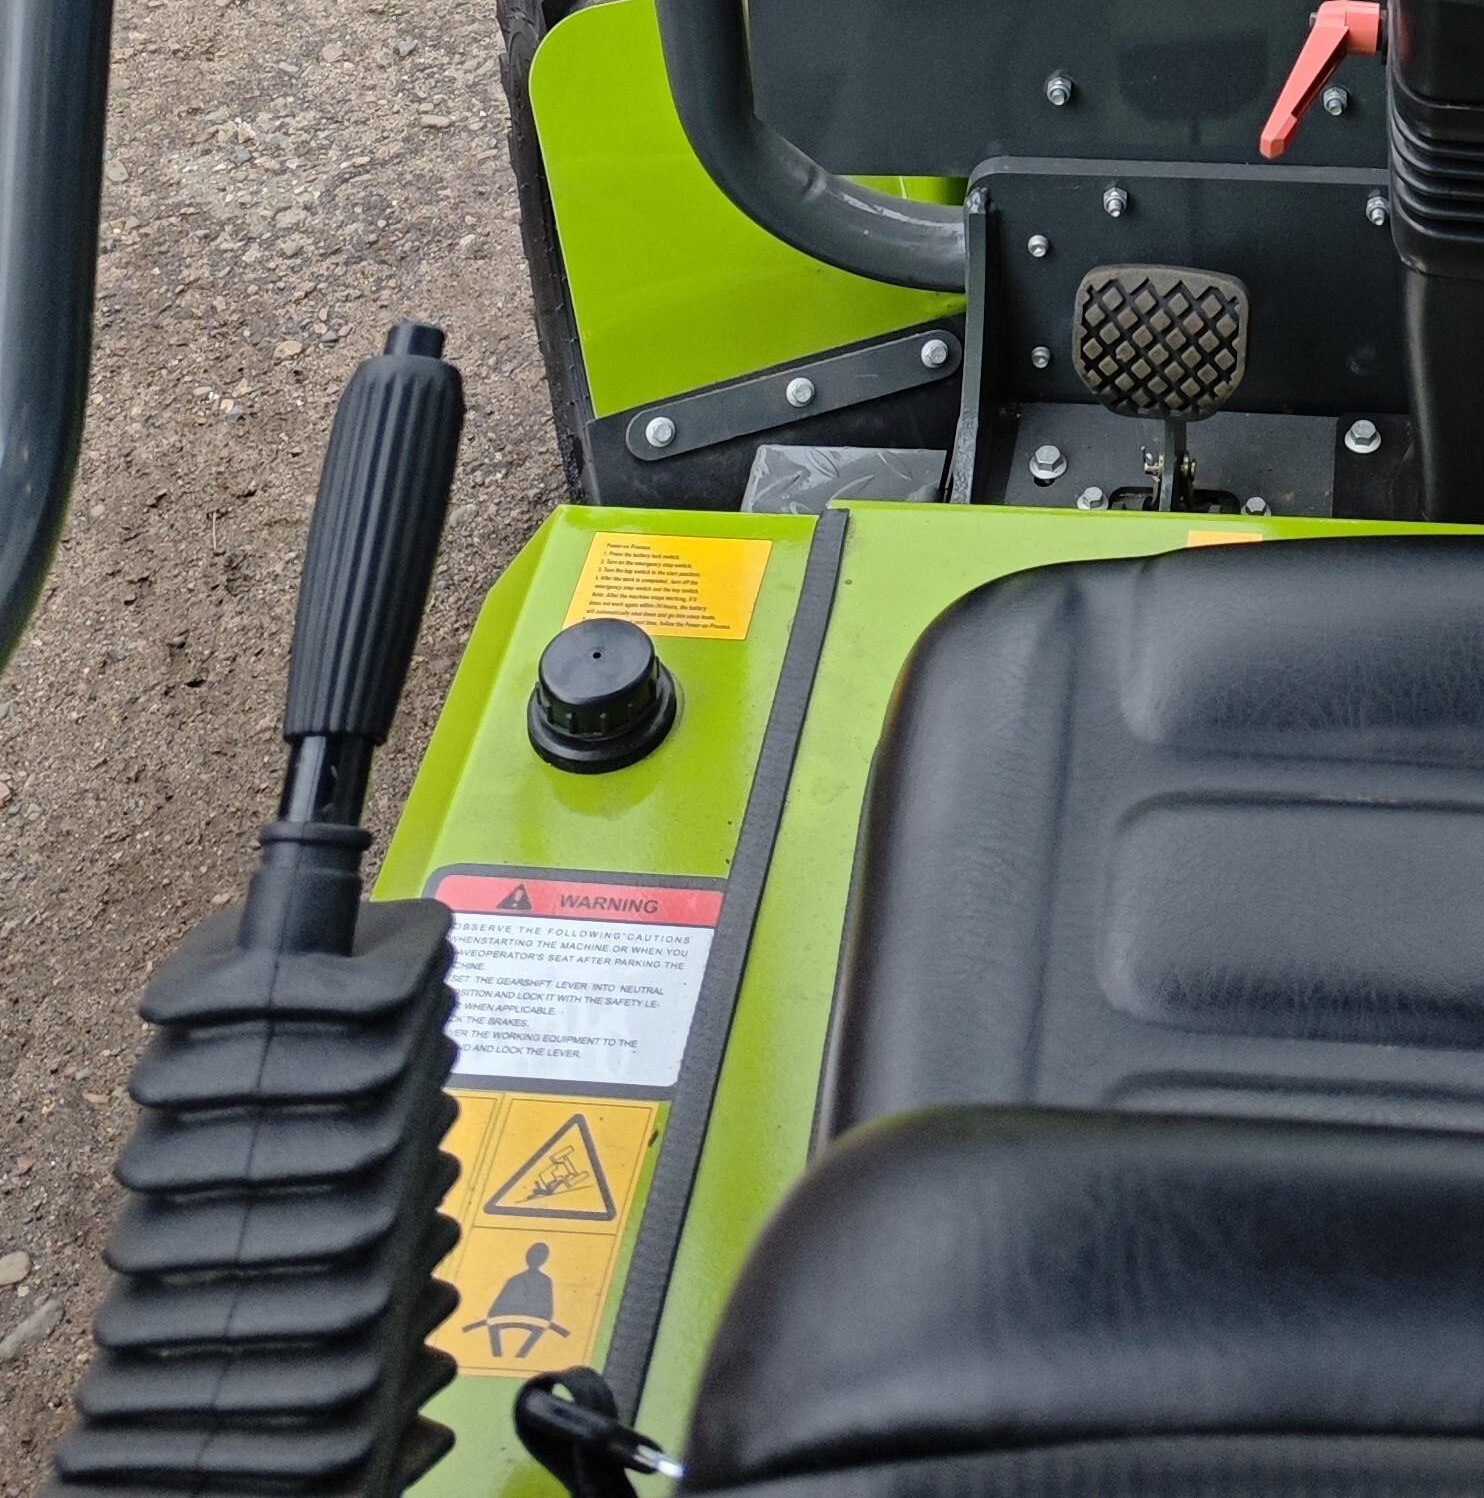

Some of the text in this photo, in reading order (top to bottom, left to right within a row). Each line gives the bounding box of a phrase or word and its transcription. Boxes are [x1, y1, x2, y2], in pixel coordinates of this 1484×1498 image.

[560, 893, 660, 914] WARNING
[519, 925, 542, 935] THE
[537, 940, 557, 950] THE
[560, 942, 610, 952] MACHINE
[612, 945, 628, 954] OR
[631, 946, 664, 956] WHEN
[666, 948, 689, 958] YOU
[547, 953, 575, 963] SEAT
[577, 955, 612, 965] AFTER
[614, 957, 661, 969] PARKING
[664, 961, 685, 970] THE
[475, 975, 495, 985] THE
[496, 976, 552, 988] GEARSHIFT
[555, 981, 588, 991] LEVER
[592, 983, 616, 992] INTO
[620, 984, 665, 996] NEUTRAL
[517, 991, 545, 1001] LOCK
[557, 994, 582, 1003] WITH
[584, 995, 603, 1005] THE
[604, 997, 642, 1007] SAFETY
[467, 1015, 487, 1025] THE
[471, 1029, 490, 1039] THE
[492, 1031, 541, 1042] WORKING
[542, 1034, 601, 1045] EQUIPMENT
[618, 1038, 639, 1048] THE
[472, 1043, 495, 1053] AND
[496, 1045, 523, 1055] LOCK
[526, 1046, 545, 1056] THE
